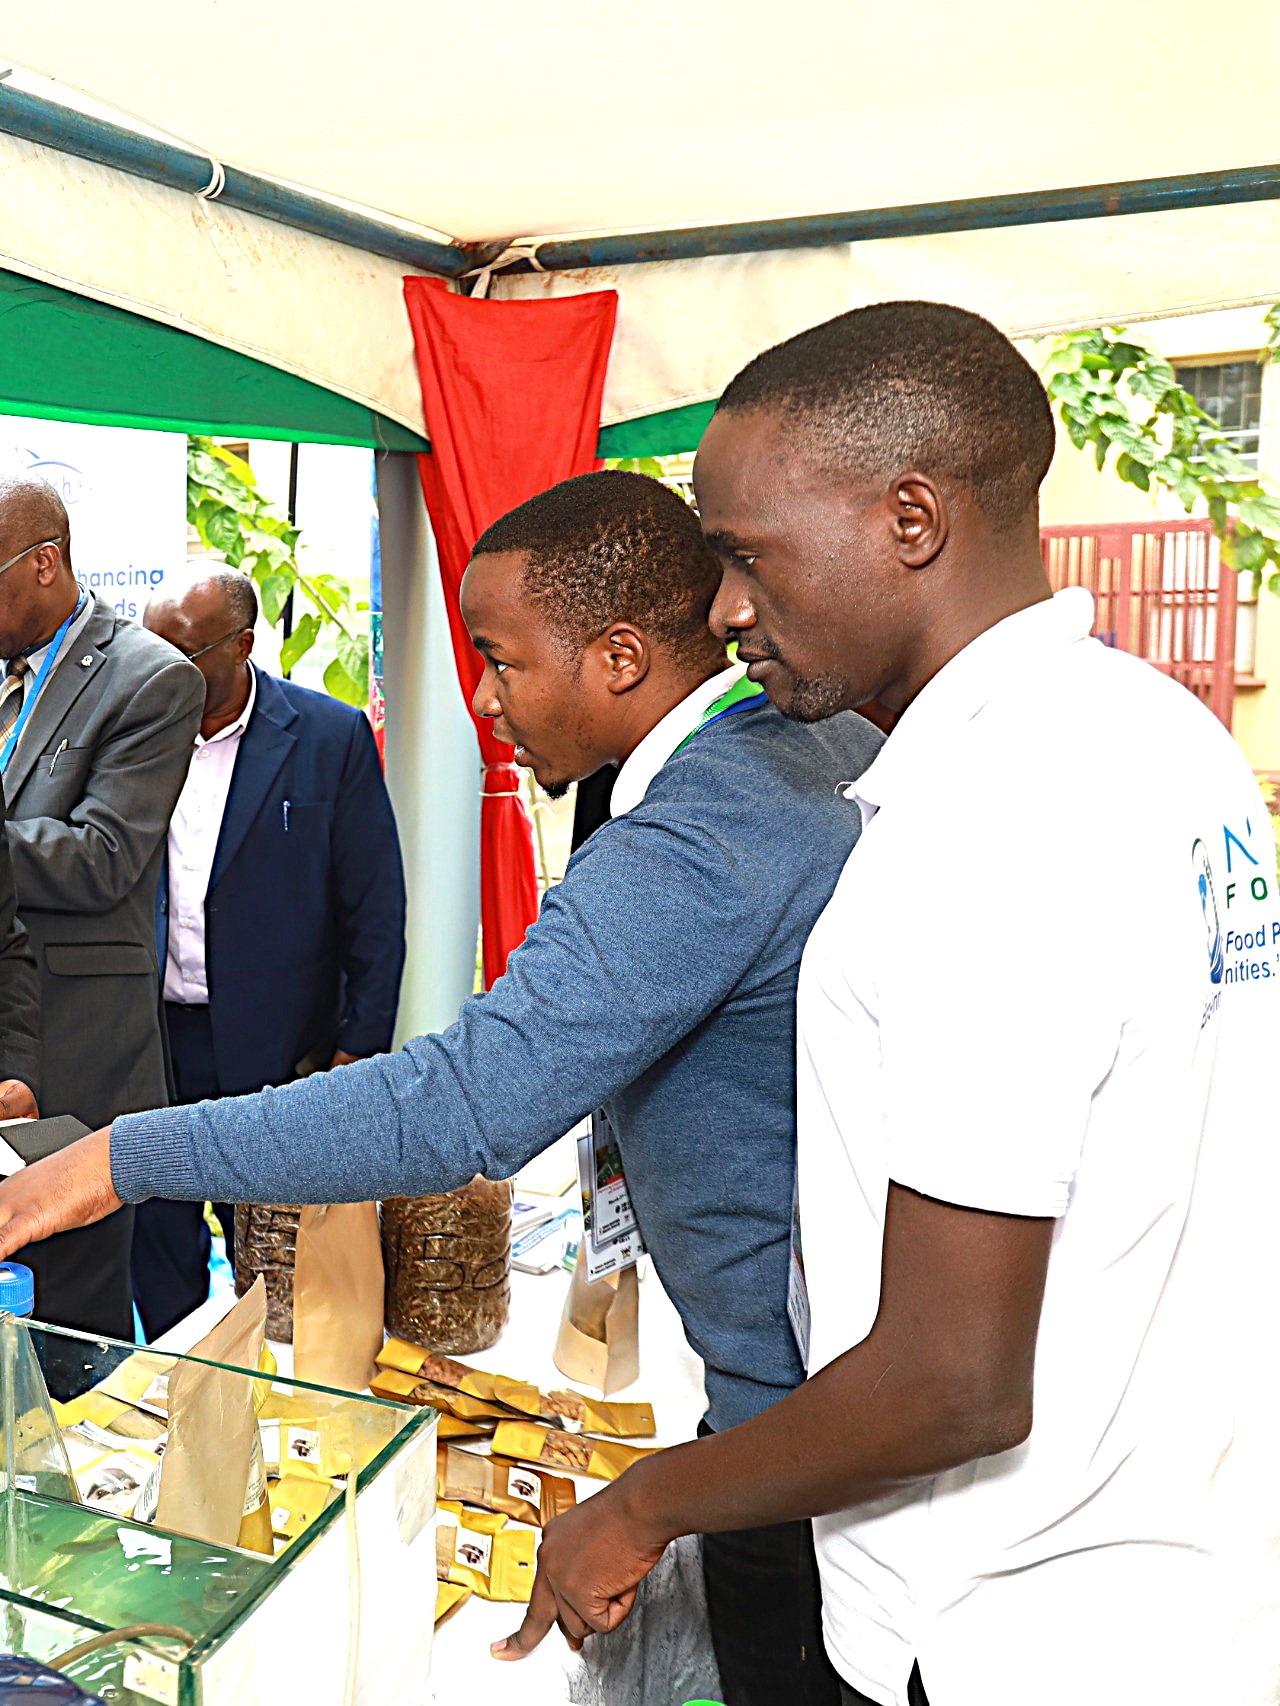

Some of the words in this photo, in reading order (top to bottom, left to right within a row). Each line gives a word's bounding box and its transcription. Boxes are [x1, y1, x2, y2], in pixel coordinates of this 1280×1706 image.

[78, 564, 164, 591] hancing
[114, 598, 137, 618] ds
[1226, 924, 1266, 953] Food
[1272, 922, 1280, 945] P
